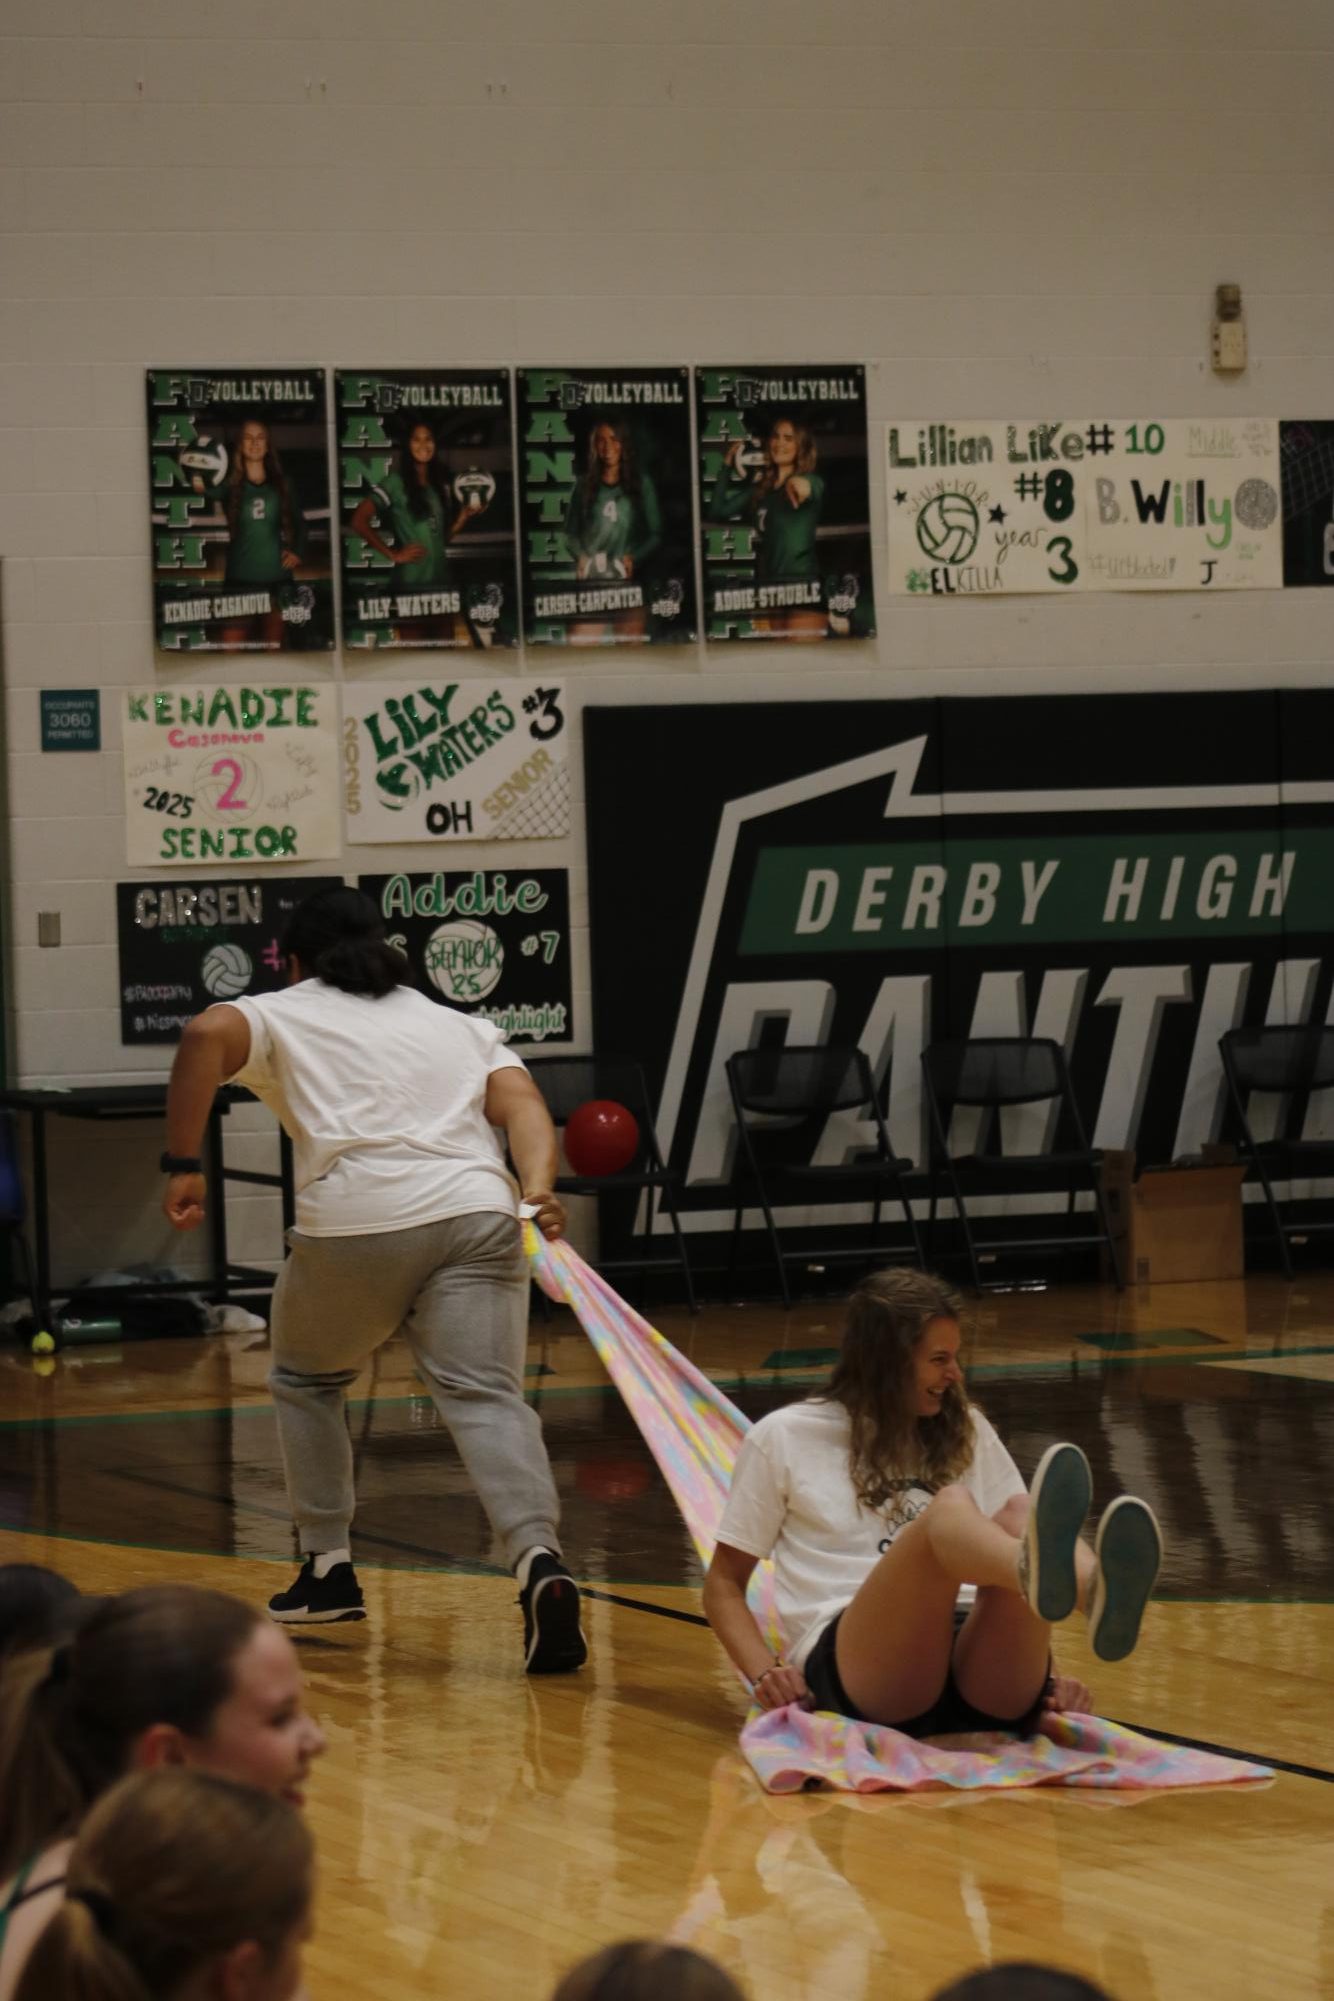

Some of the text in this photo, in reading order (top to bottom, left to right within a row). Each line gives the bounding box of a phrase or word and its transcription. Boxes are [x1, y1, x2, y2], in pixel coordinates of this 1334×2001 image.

[211, 380, 315, 401] VOLLEYBALL
[400, 384, 504, 407] VOLLEYBALL
[583, 382, 684, 405] VOLLEYBALL
[760, 379, 859, 401] VOLLEYBALL
[889, 425, 993, 468] Lillian
[252, 498, 266, 520] 2
[602, 500, 618, 522] 4
[1013, 468, 1075, 523] #8
[994, 528, 1048, 564] year
[1046, 536, 1079, 585] 3
[164, 592, 272, 624] KENADIE CASANOVA
[358, 590, 461, 621] LILY WATERS
[534, 586, 643, 618] CARSEN CARPENTER
[714, 581, 821, 612] ADDIE STRUBLE
[128, 688, 319, 729] KENADIE
[404, 690, 516, 790] WATERS
[344, 716, 362, 816] 2025
[211, 758, 248, 810] 2
[481, 748, 554, 821] SENIOR
[143, 786, 196, 819] 2025
[426, 801, 473, 835] OH
[160, 825, 298, 858] SENIOR
[134, 884, 263, 929] CARSEN
[382, 871, 549, 918] Addie
[794, 850, 1297, 936] DERBY HIGH
[427, 939, 502, 970] SENIOR
[520, 930, 560, 964] #7
[452, 973, 481, 995] 25
